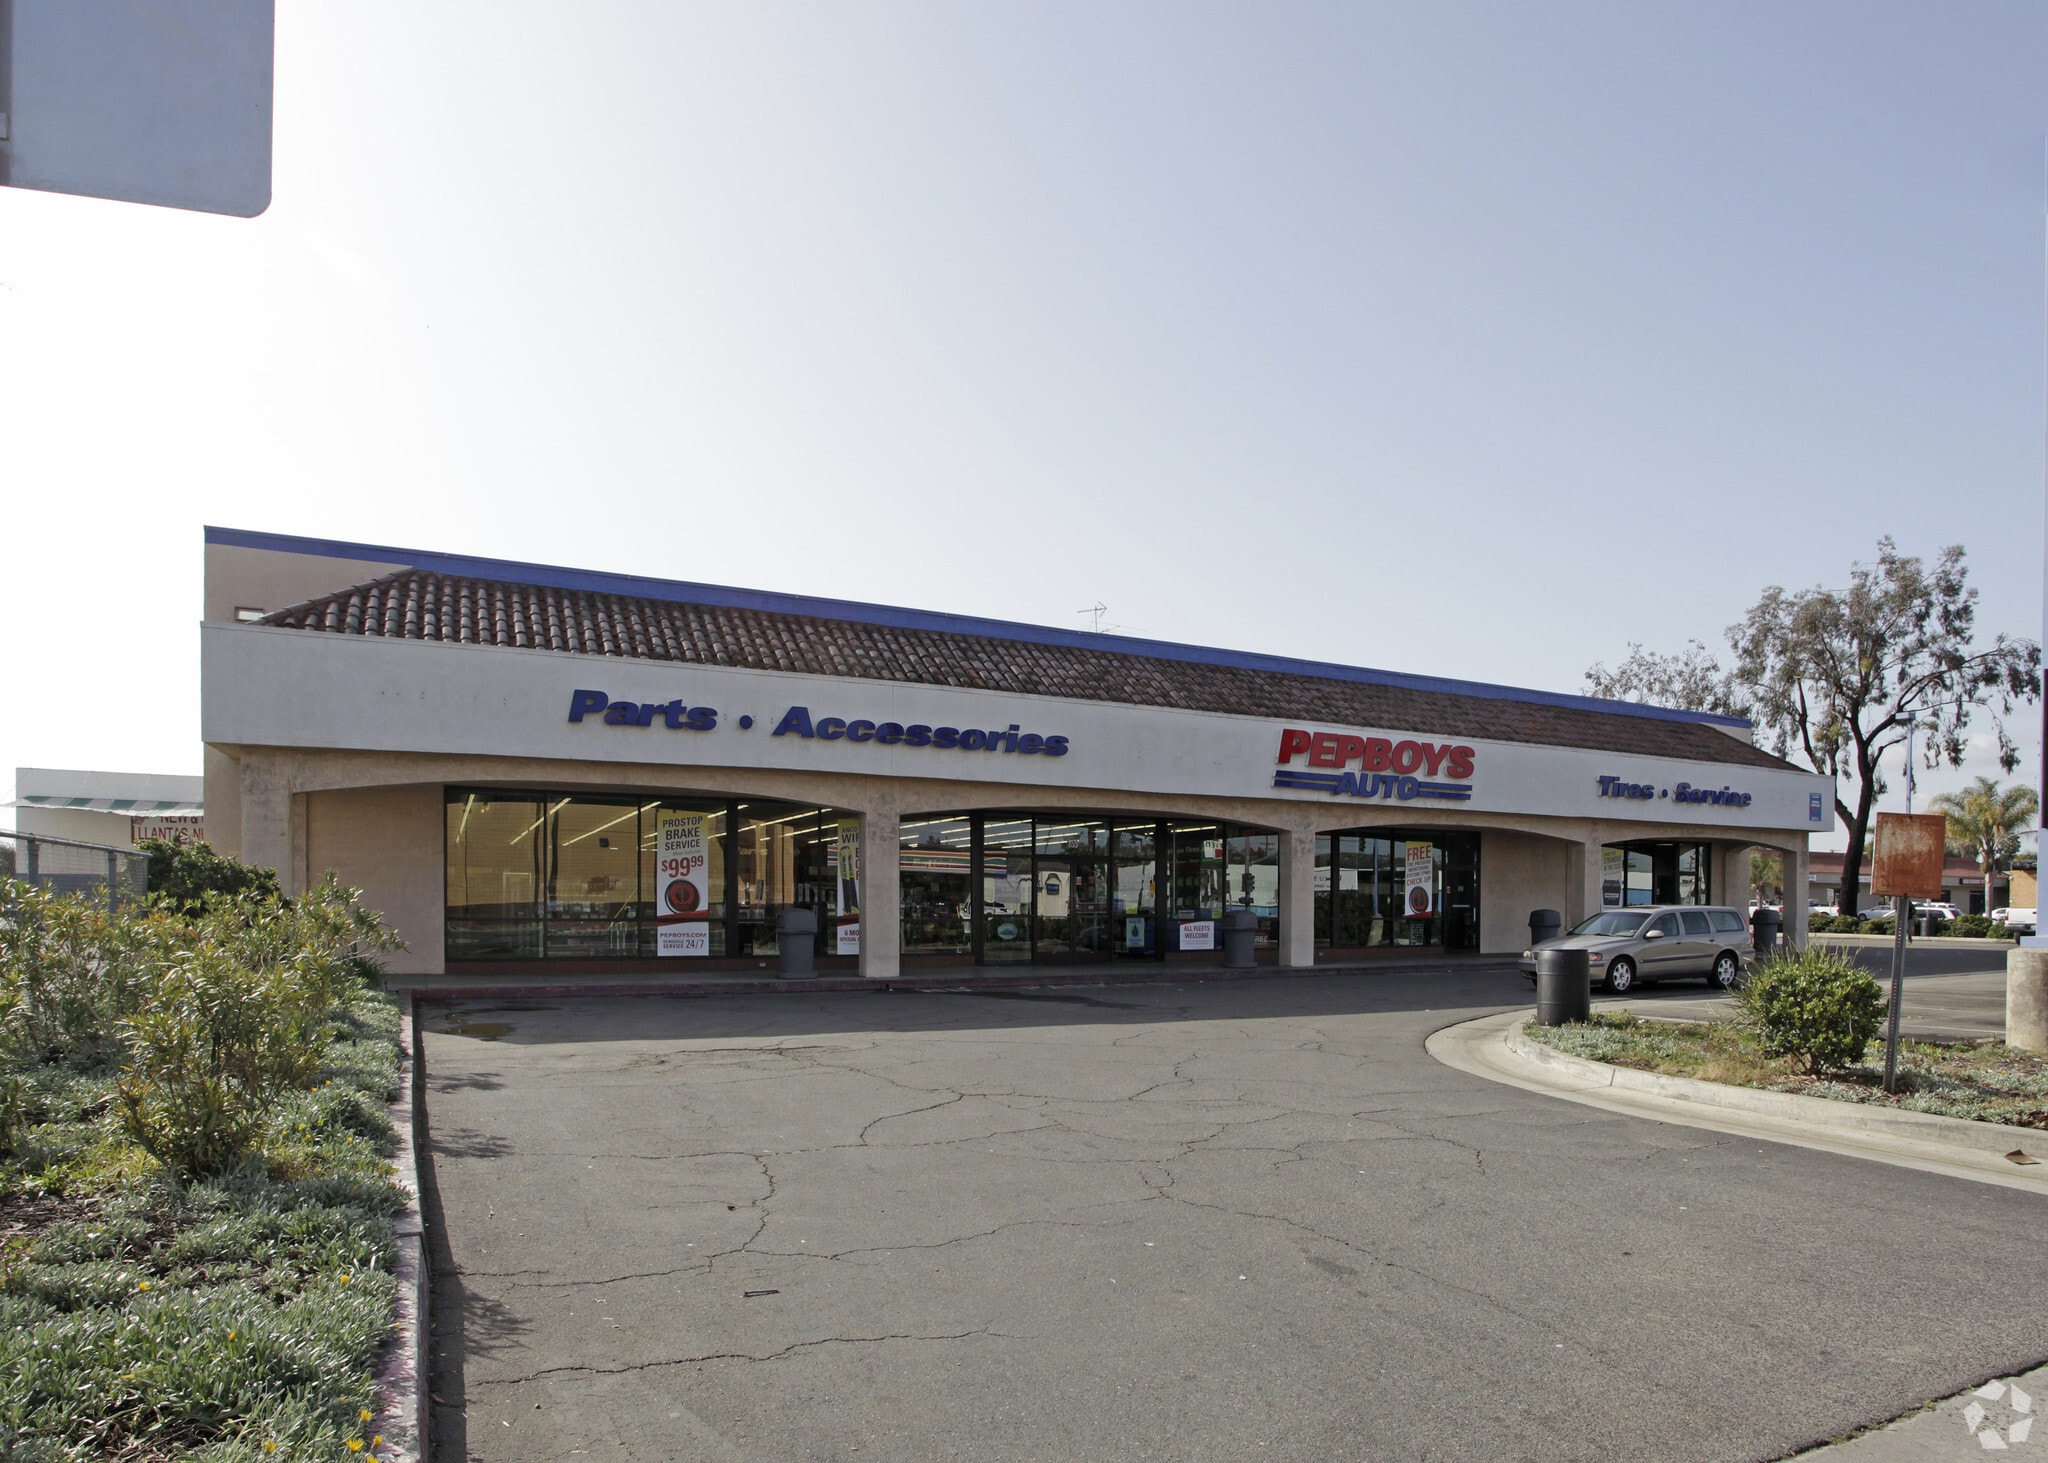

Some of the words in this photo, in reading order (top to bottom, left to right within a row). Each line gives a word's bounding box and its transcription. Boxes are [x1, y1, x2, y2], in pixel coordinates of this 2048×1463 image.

[568, 689, 718, 731] Parts
[771, 706, 1070, 756] Accessories
[1277, 728, 1476, 779] PEPBOYS
[1333, 772, 1420, 800] AUTO
[1599, 775, 1655, 800] Tires
[1674, 782, 1752, 807] Service
[662, 816, 703, 828] PROSTOP
[665, 827, 700, 840] BRAKE
[664, 838, 701, 851] SERVICE
[1407, 844, 1432, 861] FREE
[685, 939, 705, 949] 24/7
